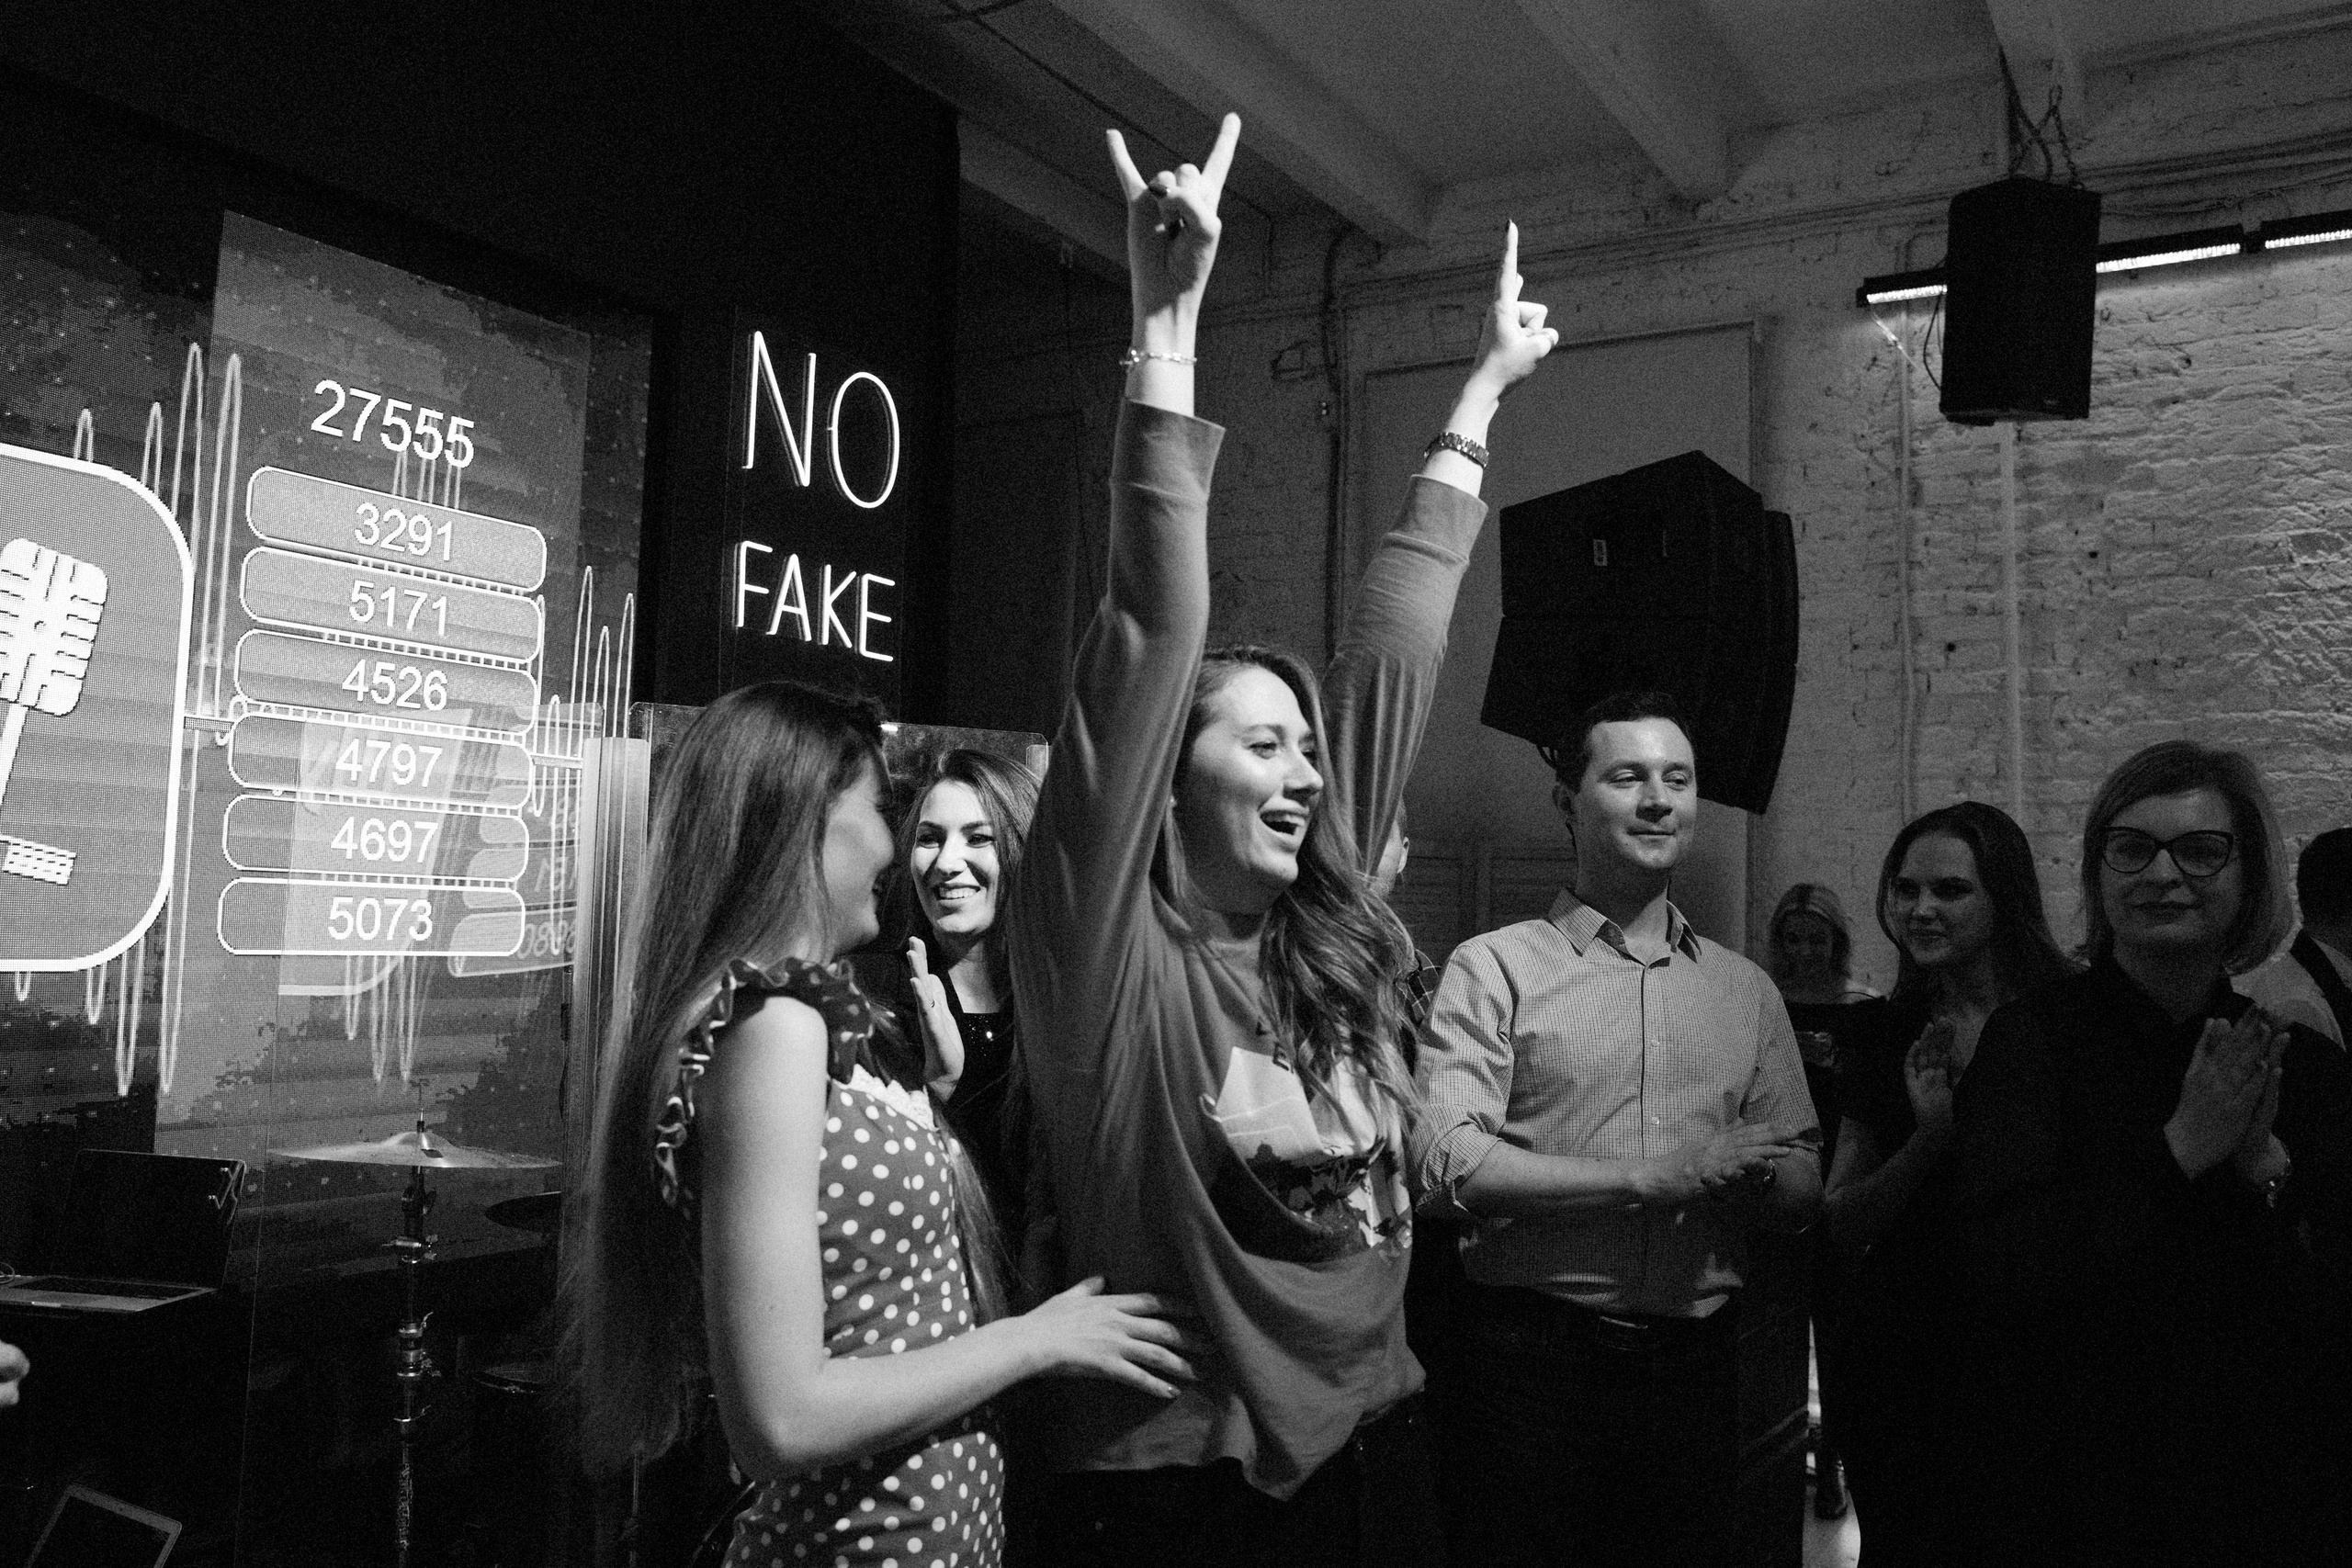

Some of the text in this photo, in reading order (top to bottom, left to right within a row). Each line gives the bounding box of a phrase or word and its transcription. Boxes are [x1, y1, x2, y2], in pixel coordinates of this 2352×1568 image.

[311, 379, 474, 468] 27555
[744, 331, 899, 509] NO
[354, 502, 453, 561] 3291
[348, 580, 448, 636] 5171
[736, 540, 896, 661] FAKE
[341, 658, 448, 711] 4526
[334, 738, 444, 788] 4797
[330, 816, 439, 863] 4697
[327, 897, 434, 942] 5073
